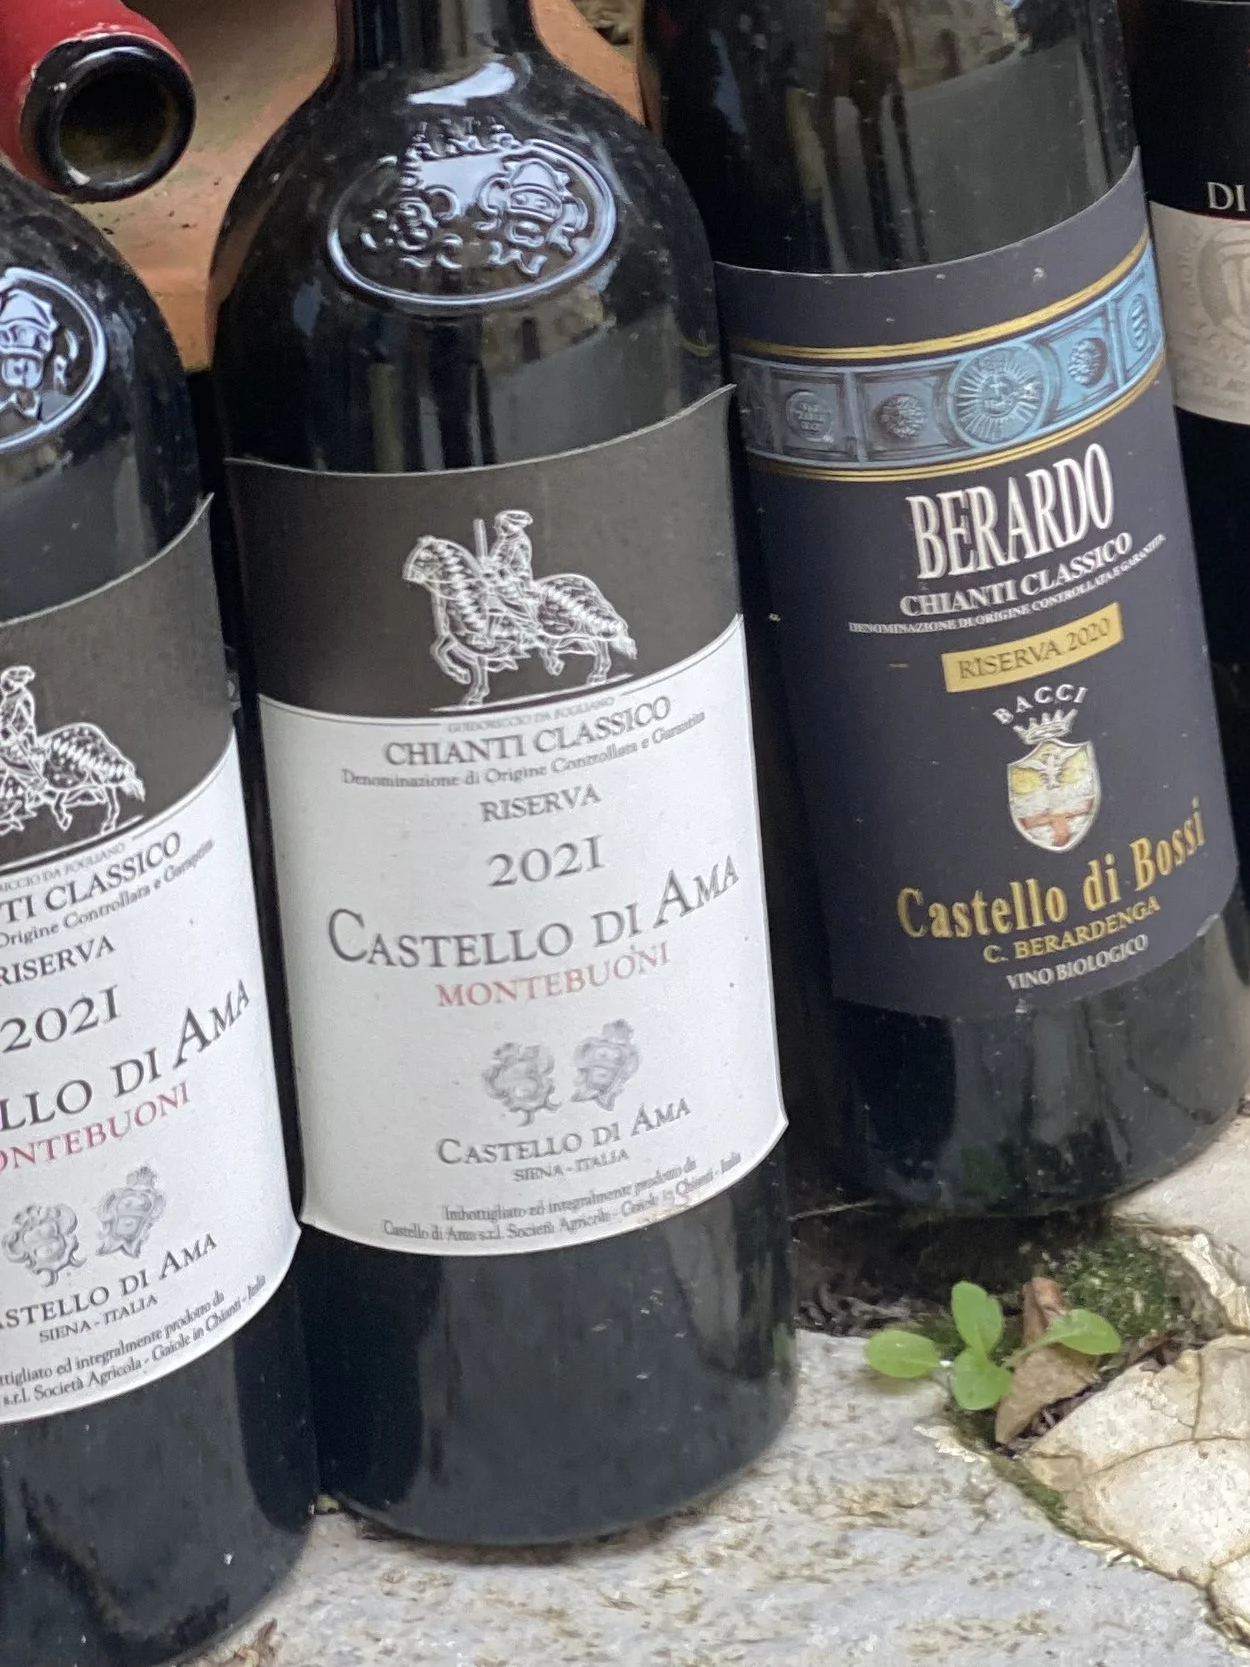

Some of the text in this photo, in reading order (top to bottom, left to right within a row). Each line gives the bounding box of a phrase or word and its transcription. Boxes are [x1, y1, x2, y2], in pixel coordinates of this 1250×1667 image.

[1206, 181, 1247, 212] DI
[905, 443, 1115, 580] BERARDO
[899, 532, 1133, 617] CHIANTI CLASSICO
[848, 618, 957, 634] DENOMINAZIONE
[958, 617, 974, 629] DI
[975, 603, 1031, 625] ORIGINE
[957, 617, 1111, 681] RISERVA 2020
[384, 695, 672, 766] CHIANTI CLASSICO
[992, 682, 1089, 725] BACCI
[341, 767, 461, 788] Denominazione
[465, 770, 480, 785] di
[485, 763, 548, 784] Origine
[550, 743, 638, 774] Controllata
[641, 737, 650, 749] e
[480, 783, 603, 823] RISERVA
[0, 832, 181, 924] TI CLASSICO
[487, 835, 606, 888] 2021
[896, 796, 1206, 939] Castello di Bossi
[63, 884, 151, 929] Controllata
[327, 855, 740, 968] CASTELLO DI AMA
[982, 896, 1162, 964] C. BERARDENGA
[0, 935, 116, 986] RISERVA
[435, 941, 671, 1008] MONTEBUONI
[1005, 934, 1150, 991] VINO BIOLOGICO
[1, 984, 121, 1054] 2021
[0, 978, 251, 1132] LLO DI AMA
[436, 1097, 692, 1166] CASTELLO DI AMA
[513, 1165, 565, 1183] SIENA
[575, 1148, 631, 1173] ITALIA
[383, 1219, 429, 1240] Castello
[431, 1224, 443, 1241] di
[447, 1226, 477, 1242] Ama
[443, 1203, 527, 1223] Imbottigliato
[529, 1199, 545, 1216] ed
[119, 1268, 150, 1297] DI
[158, 1232, 218, 1282] AMA
[39, 1320, 92, 1344] SIENA
[103, 1294, 159, 1326] ITALIA
[3, 1389, 31, 1406] s.r.l.
[34, 1376, 85, 1402] Società
[88, 1356, 143, 1388] Agricola
[151, 1336, 191, 1363] Gaiole
[56, 1356, 73, 1376] ed
[76, 1328, 163, 1370] integralmente
